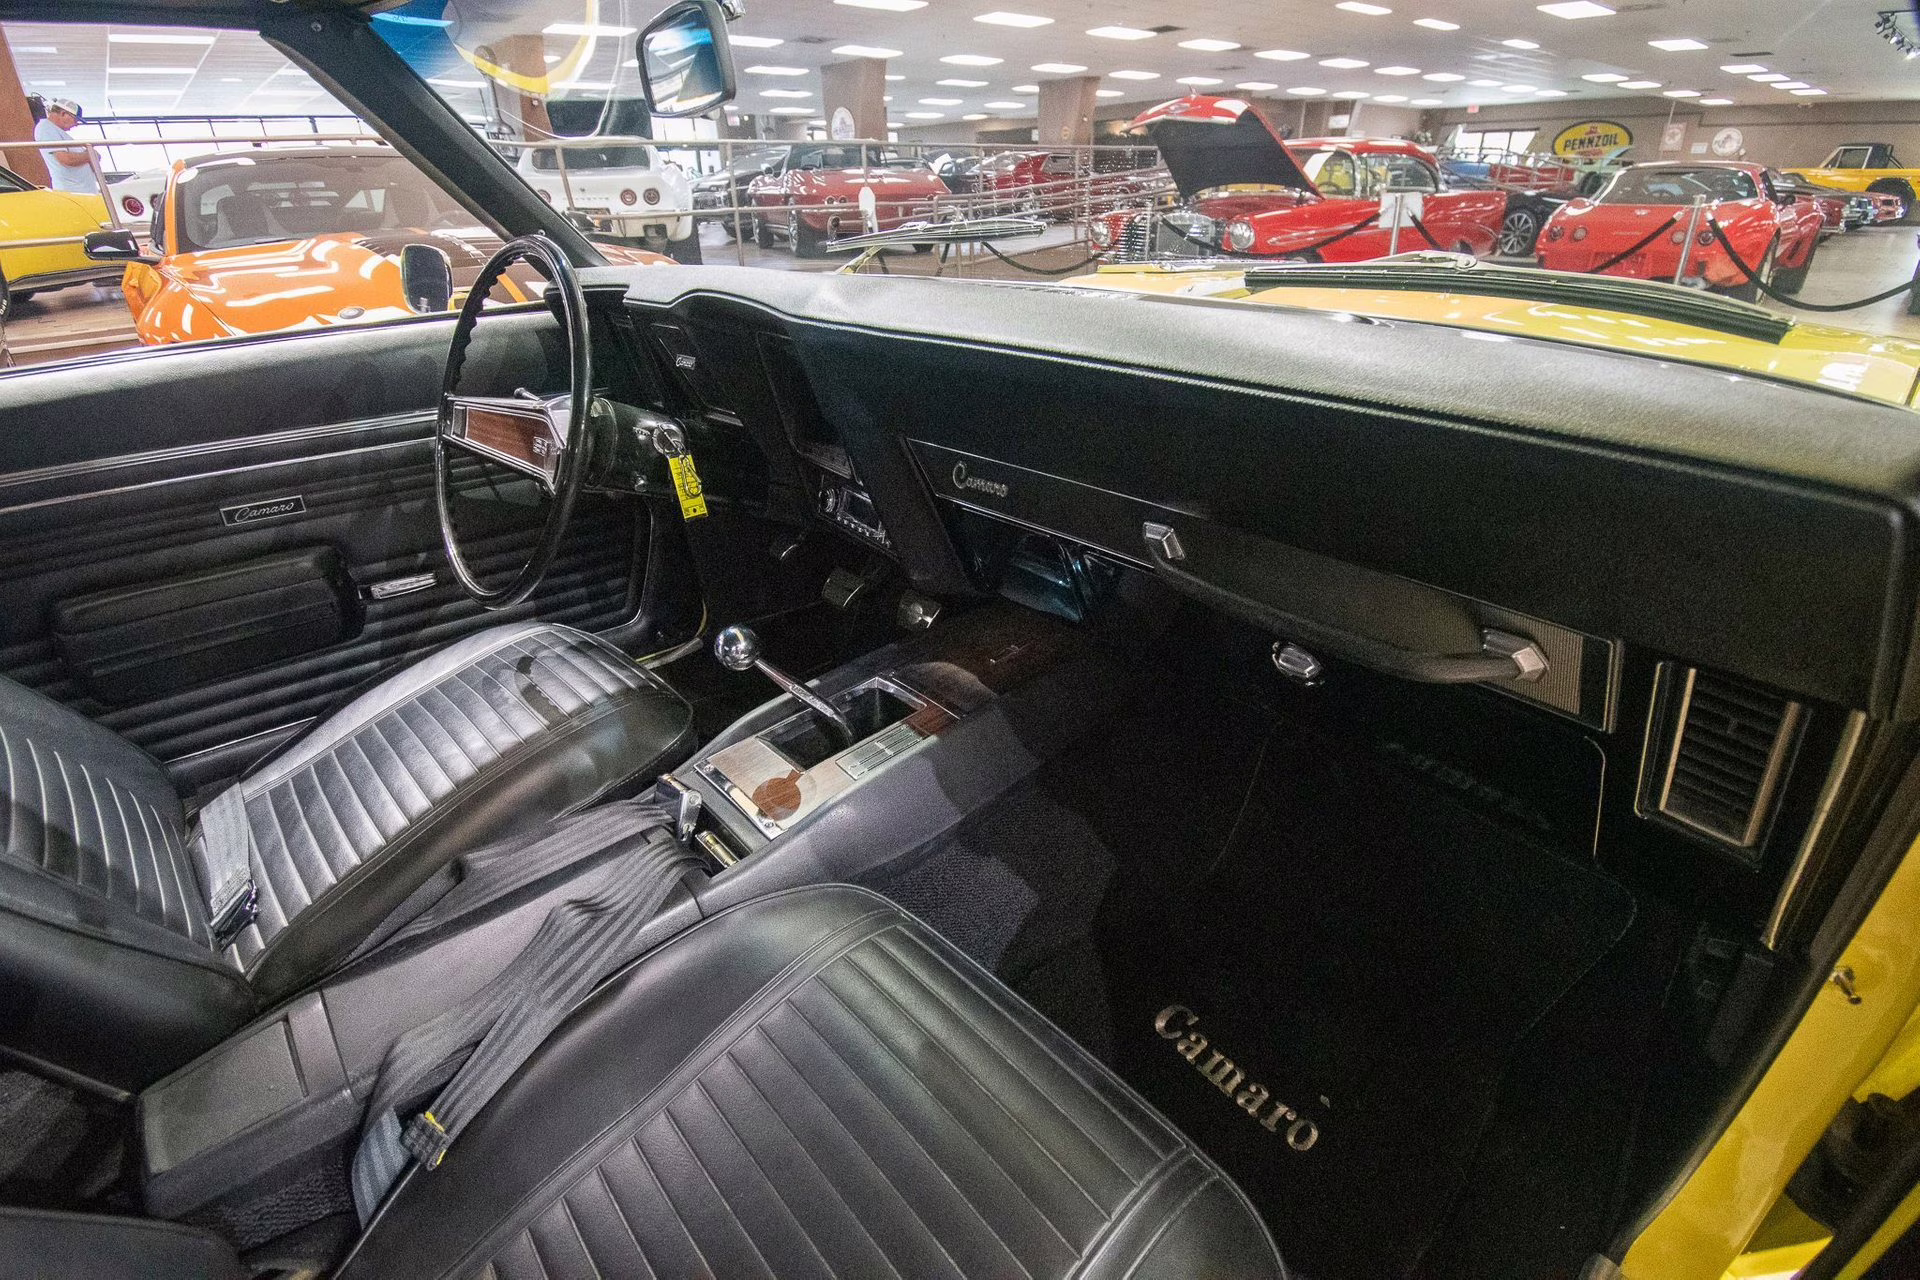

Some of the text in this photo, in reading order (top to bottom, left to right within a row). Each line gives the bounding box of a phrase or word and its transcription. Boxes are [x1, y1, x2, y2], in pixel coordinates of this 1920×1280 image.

[1563, 133, 1618, 151] PENNZOIL
[952, 461, 1009, 498] Camaro
[234, 502, 295, 523] Camaro
[1154, 1004, 1320, 1151] Camaro
